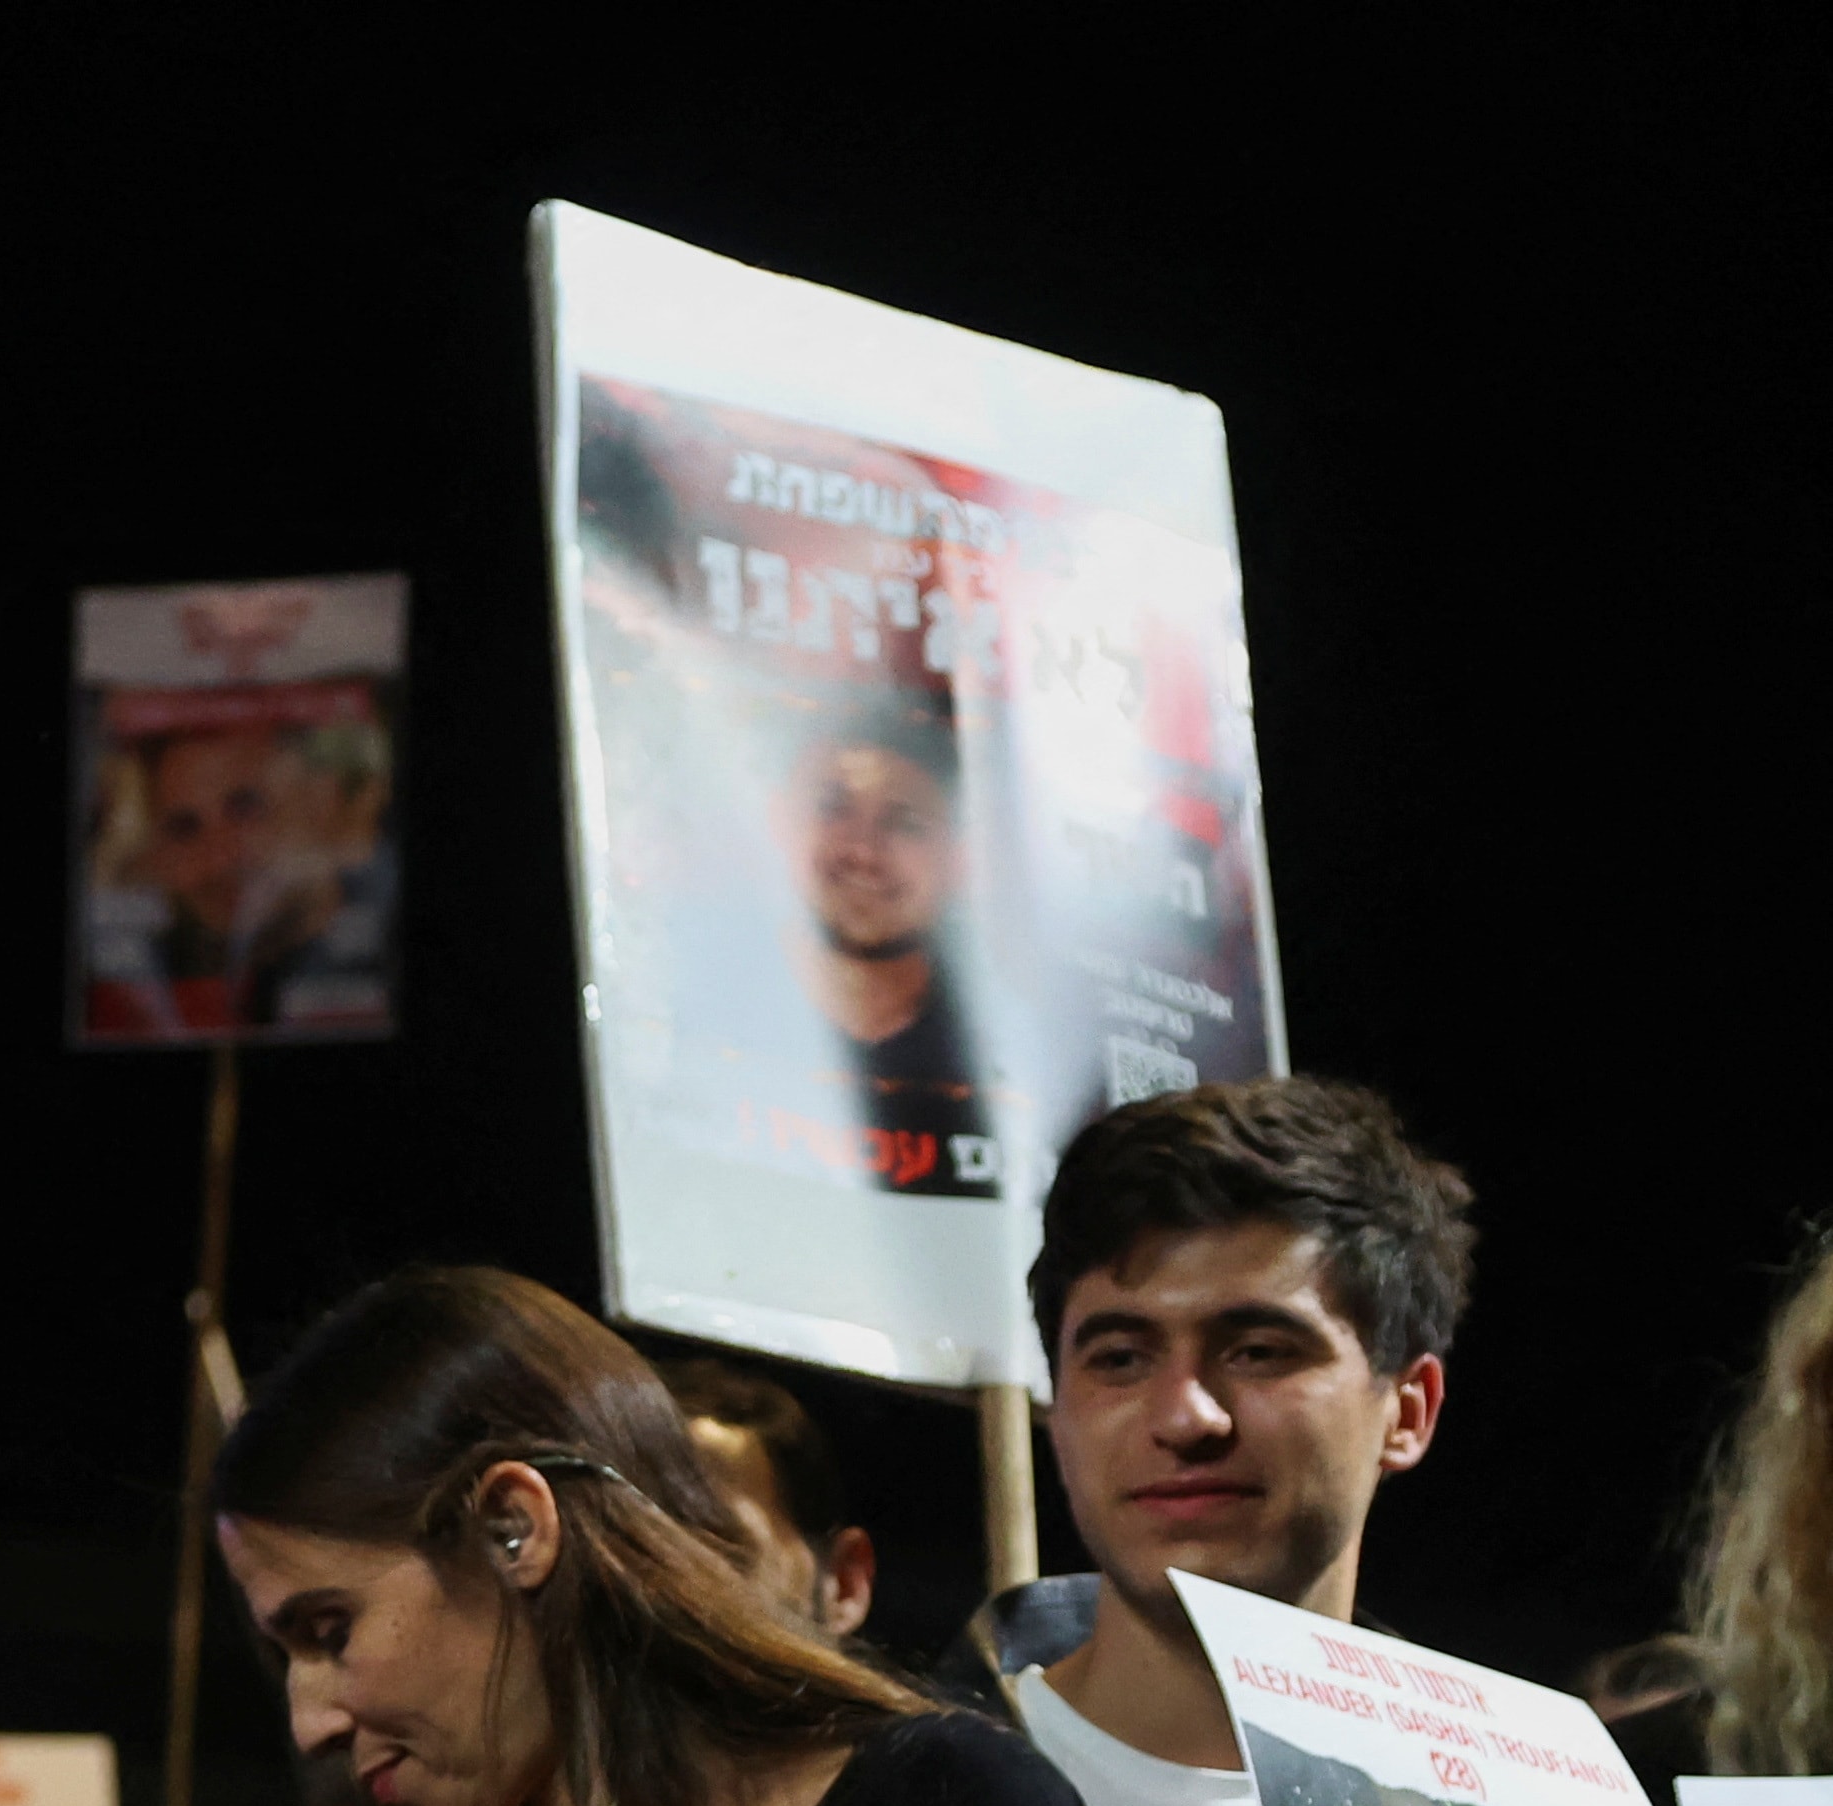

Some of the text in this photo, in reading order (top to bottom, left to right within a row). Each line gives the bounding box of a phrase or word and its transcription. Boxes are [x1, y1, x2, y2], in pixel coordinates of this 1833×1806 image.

[1233, 1655, 1630, 1794] ALEXANDER (SASHA) TROUFANOV
[1429, 1749, 1488, 1802] (28)
